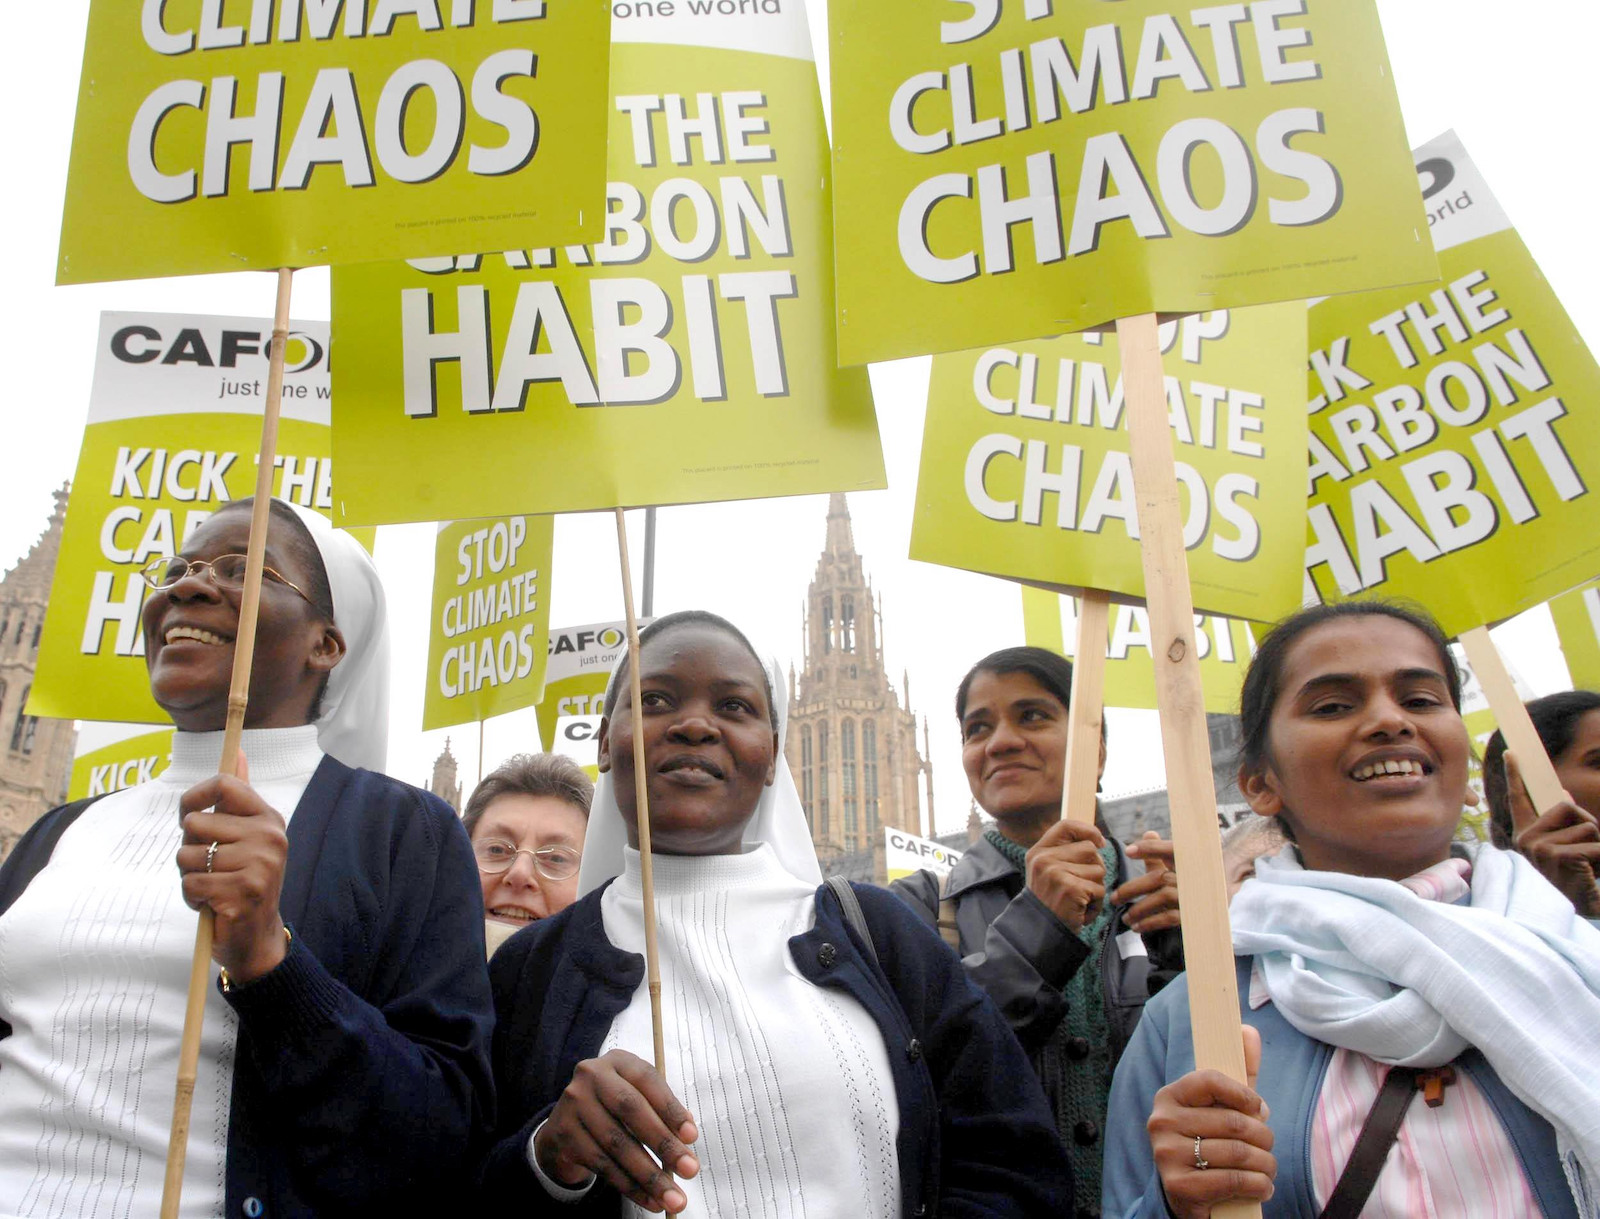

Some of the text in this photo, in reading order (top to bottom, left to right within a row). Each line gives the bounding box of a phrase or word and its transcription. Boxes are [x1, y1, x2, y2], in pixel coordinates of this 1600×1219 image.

[141, 0, 547, 55] CLIM
[612, 0, 782, 19] one world
[889, 0, 1323, 154] CLIMATE
[127, 49, 540, 204] CHAOS
[615, 90, 778, 169] THE
[405, 174, 794, 276] BON
[897, 107, 1344, 285] CHAOS
[1426, 190, 1474, 227] orld
[111, 325, 332, 374] CAFO
[401, 270, 798, 420] HABIT
[1368, 269, 1512, 370] THE
[219, 377, 260, 399] just
[282, 384, 308, 400] ne
[1307, 328, 1553, 498] ARBON
[109, 446, 238, 502] KICK
[1303, 396, 1590, 607] HABIT
[457, 516, 527, 586] STOP
[442, 569, 538, 639] CLIMATE
[439, 623, 535, 699] CHAOS
[549, 626, 645, 655] AFO
[580, 654, 598, 667] just
[88, 755, 159, 799] KICK
[890, 834, 960, 868] CAFOD
